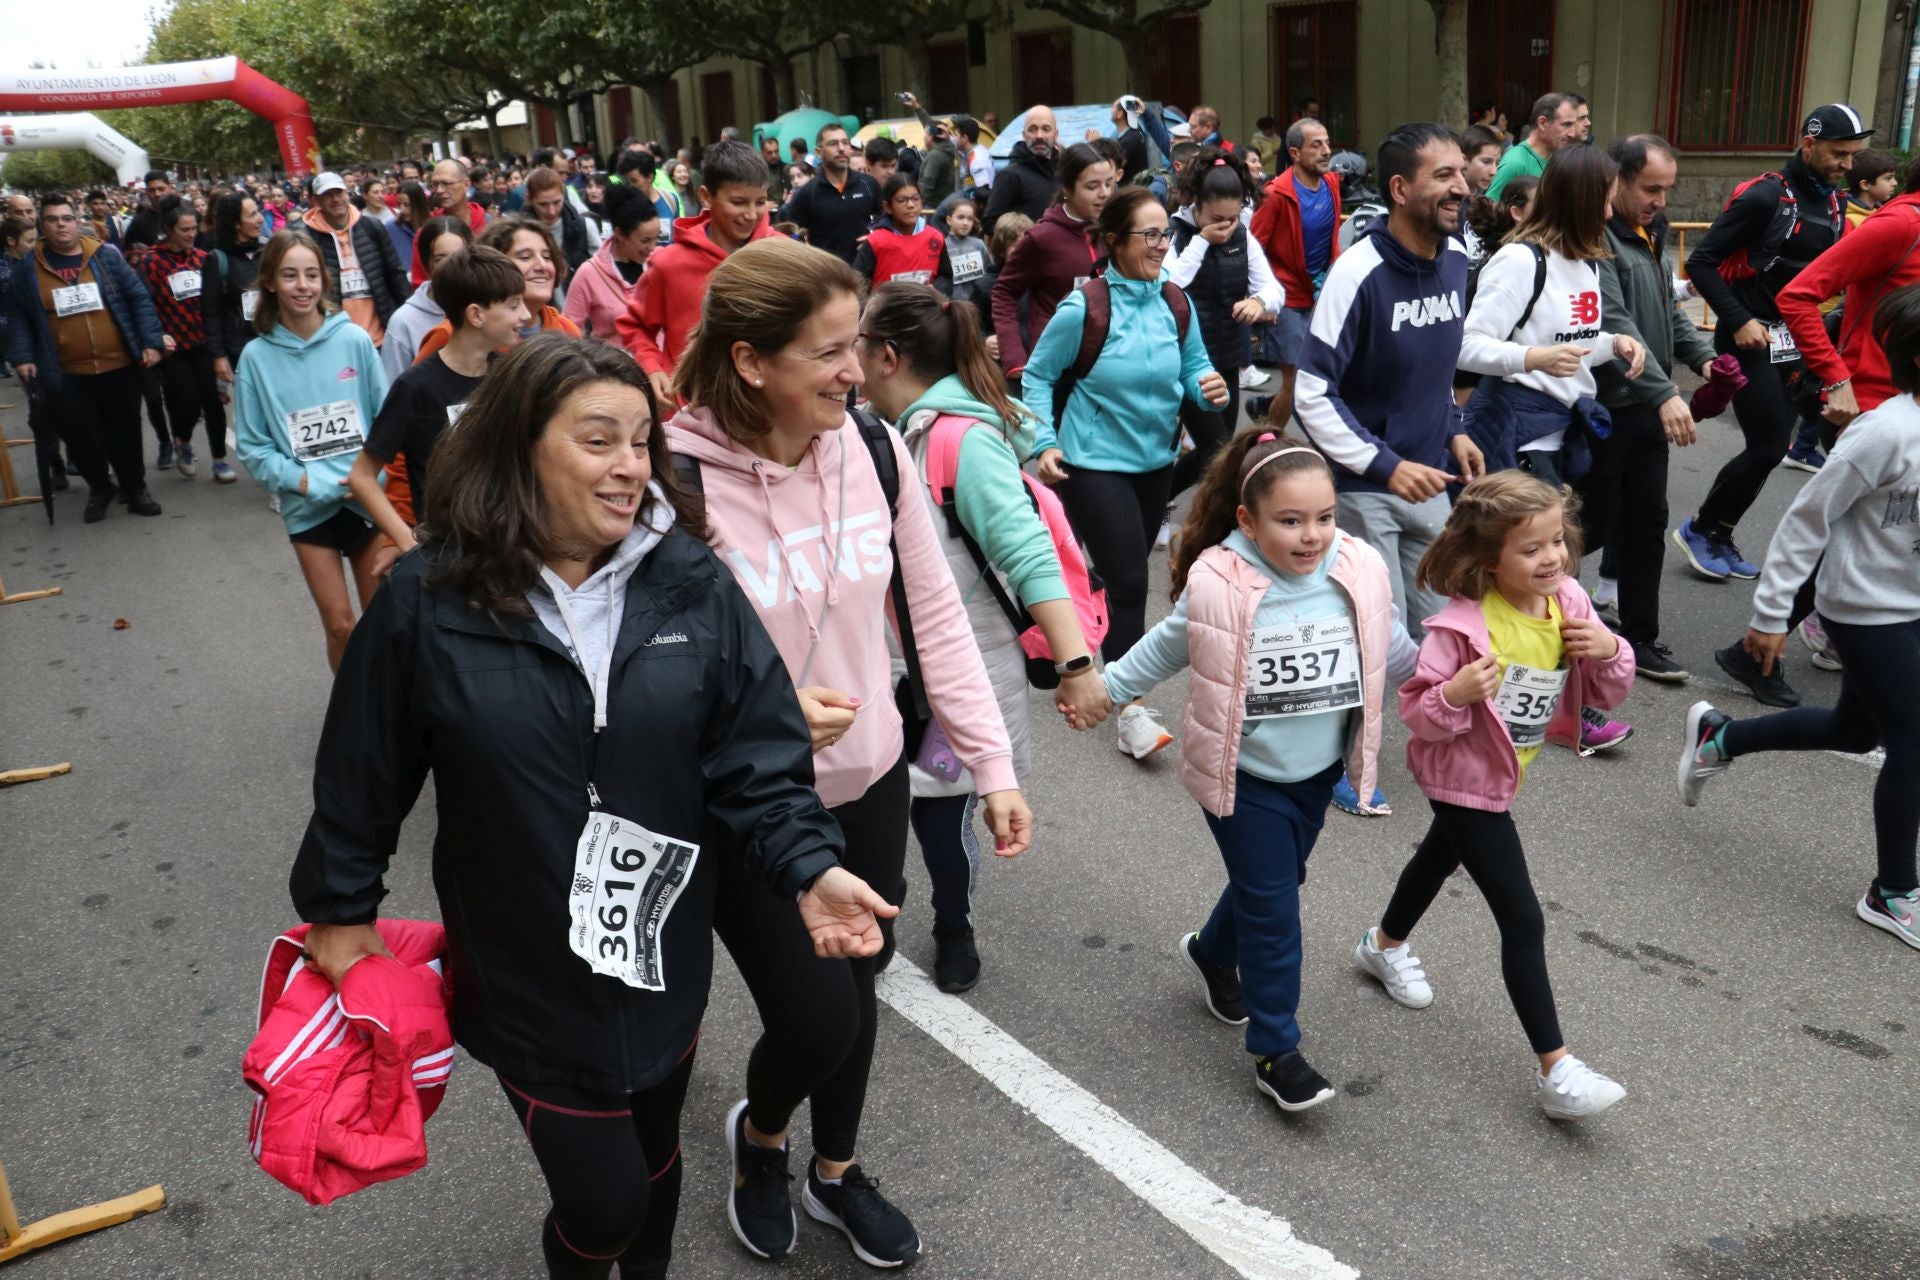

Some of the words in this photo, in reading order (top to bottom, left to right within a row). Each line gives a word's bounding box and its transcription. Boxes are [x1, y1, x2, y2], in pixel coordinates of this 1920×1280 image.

[16, 77, 121, 90] AYUNTAMIENTO
[125, 75, 141, 86] DE
[954, 260, 979, 274] 3162
[183, 278, 195, 289] 67
[345, 278, 364, 290] 177
[66, 292, 87, 306] 332
[1391, 290, 1462, 332] PUMA
[300, 417, 350, 443] 2742
[727, 520, 887, 609] VANS
[1257, 648, 1340, 687] 3537
[1296, 699, 1330, 710] HYUNDAI
[598, 846, 647, 963] 3616
[650, 883, 673, 920] HYUNDAI
